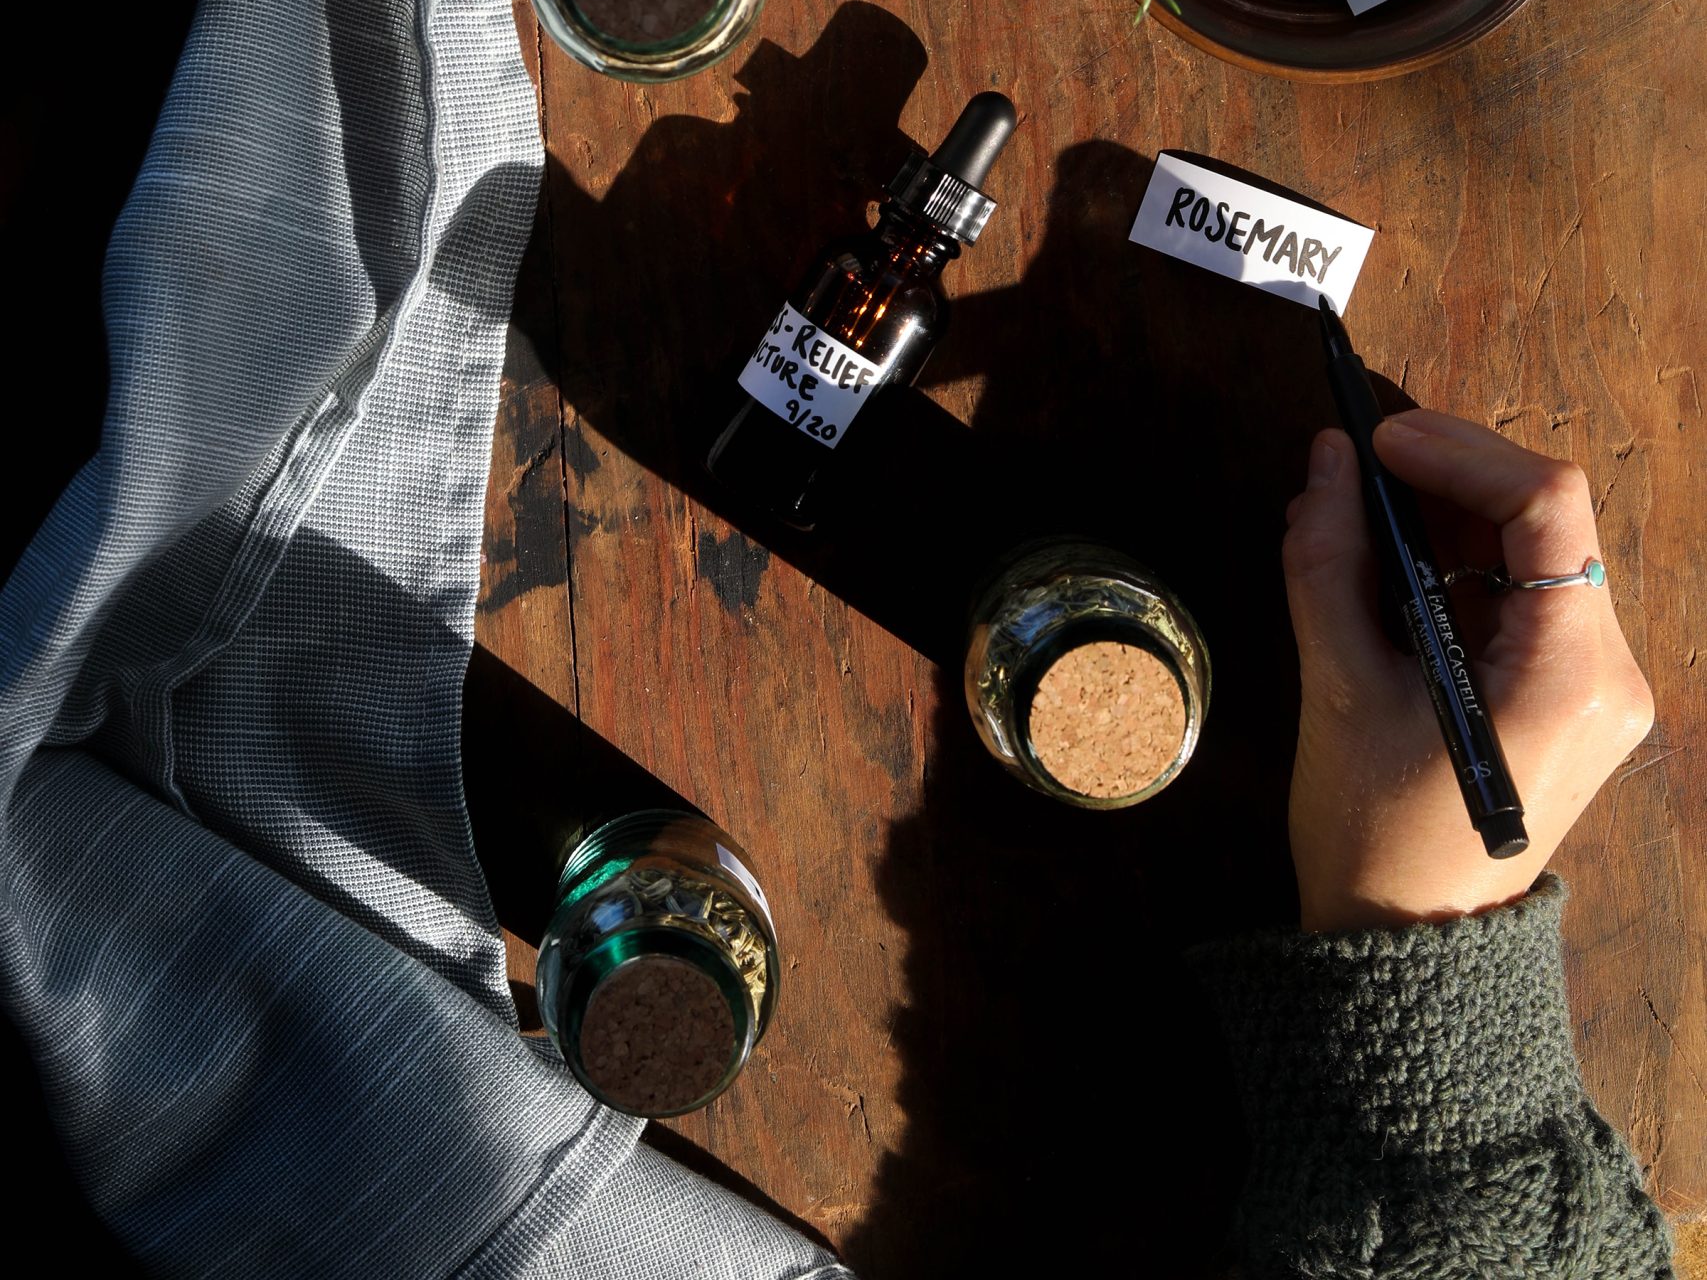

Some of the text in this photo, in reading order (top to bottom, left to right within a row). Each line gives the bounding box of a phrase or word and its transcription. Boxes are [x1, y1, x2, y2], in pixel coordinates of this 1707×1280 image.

[1164, 186, 1343, 285] ROSEMARY
[785, 399, 838, 441] 9/20
[1416, 623, 1436, 657] Artist
[1429, 658, 1444, 683] Pen
[1428, 594, 1479, 714] FABER-CASTELL
